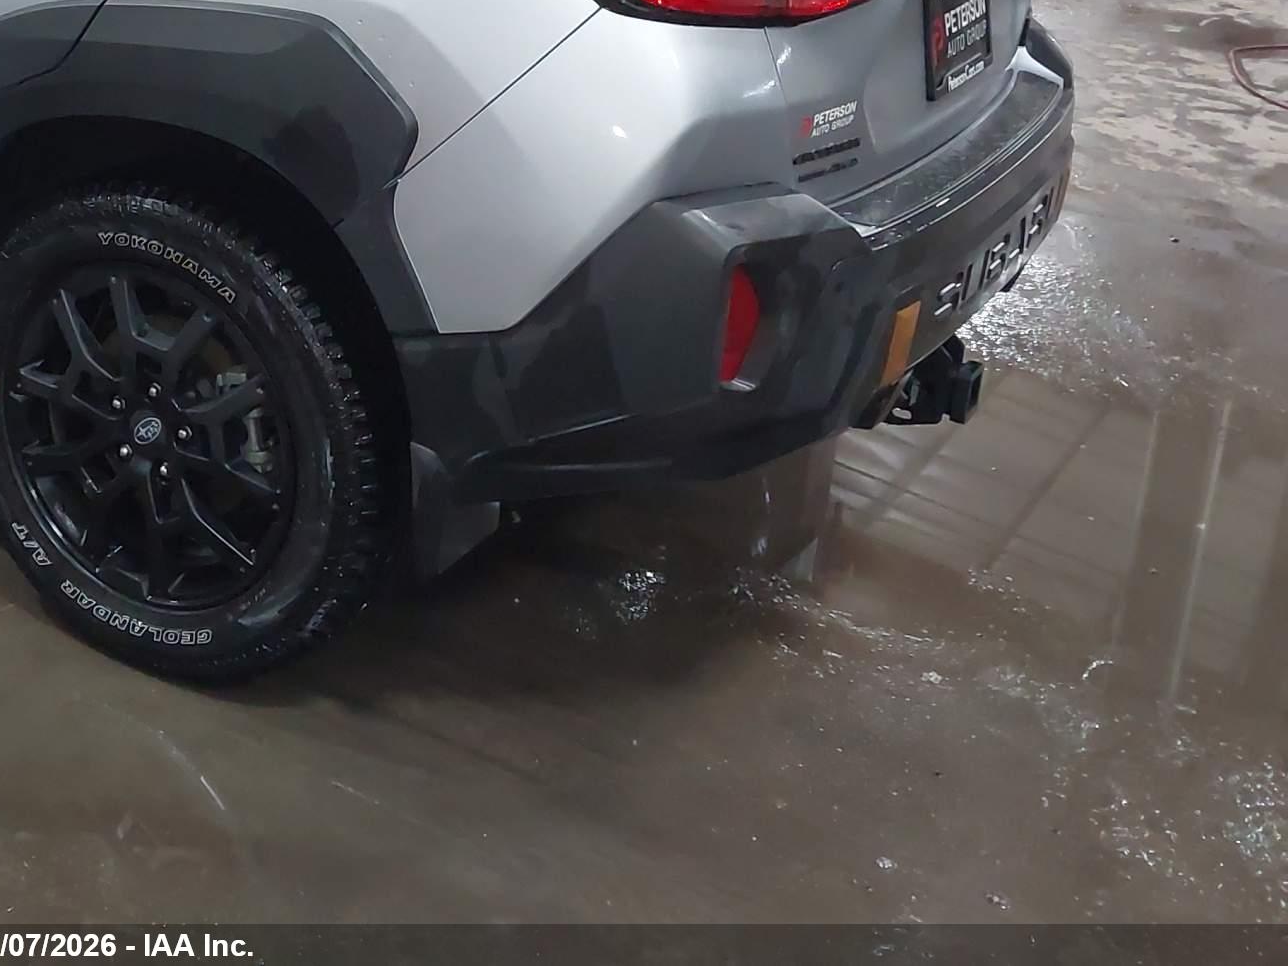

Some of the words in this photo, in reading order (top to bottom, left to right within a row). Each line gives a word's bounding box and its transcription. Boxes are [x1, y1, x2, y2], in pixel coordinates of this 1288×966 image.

[947, 33, 966, 59] AUTO
[966, 18, 987, 46] GROUP
[811, 123, 830, 139] AUTO
[813, 100, 858, 127] PETERSON
[98, 232, 237, 304] YOKOHAMA
[12, 521, 53, 566] A/T
[60, 578, 212, 645] GEOLANDAR
